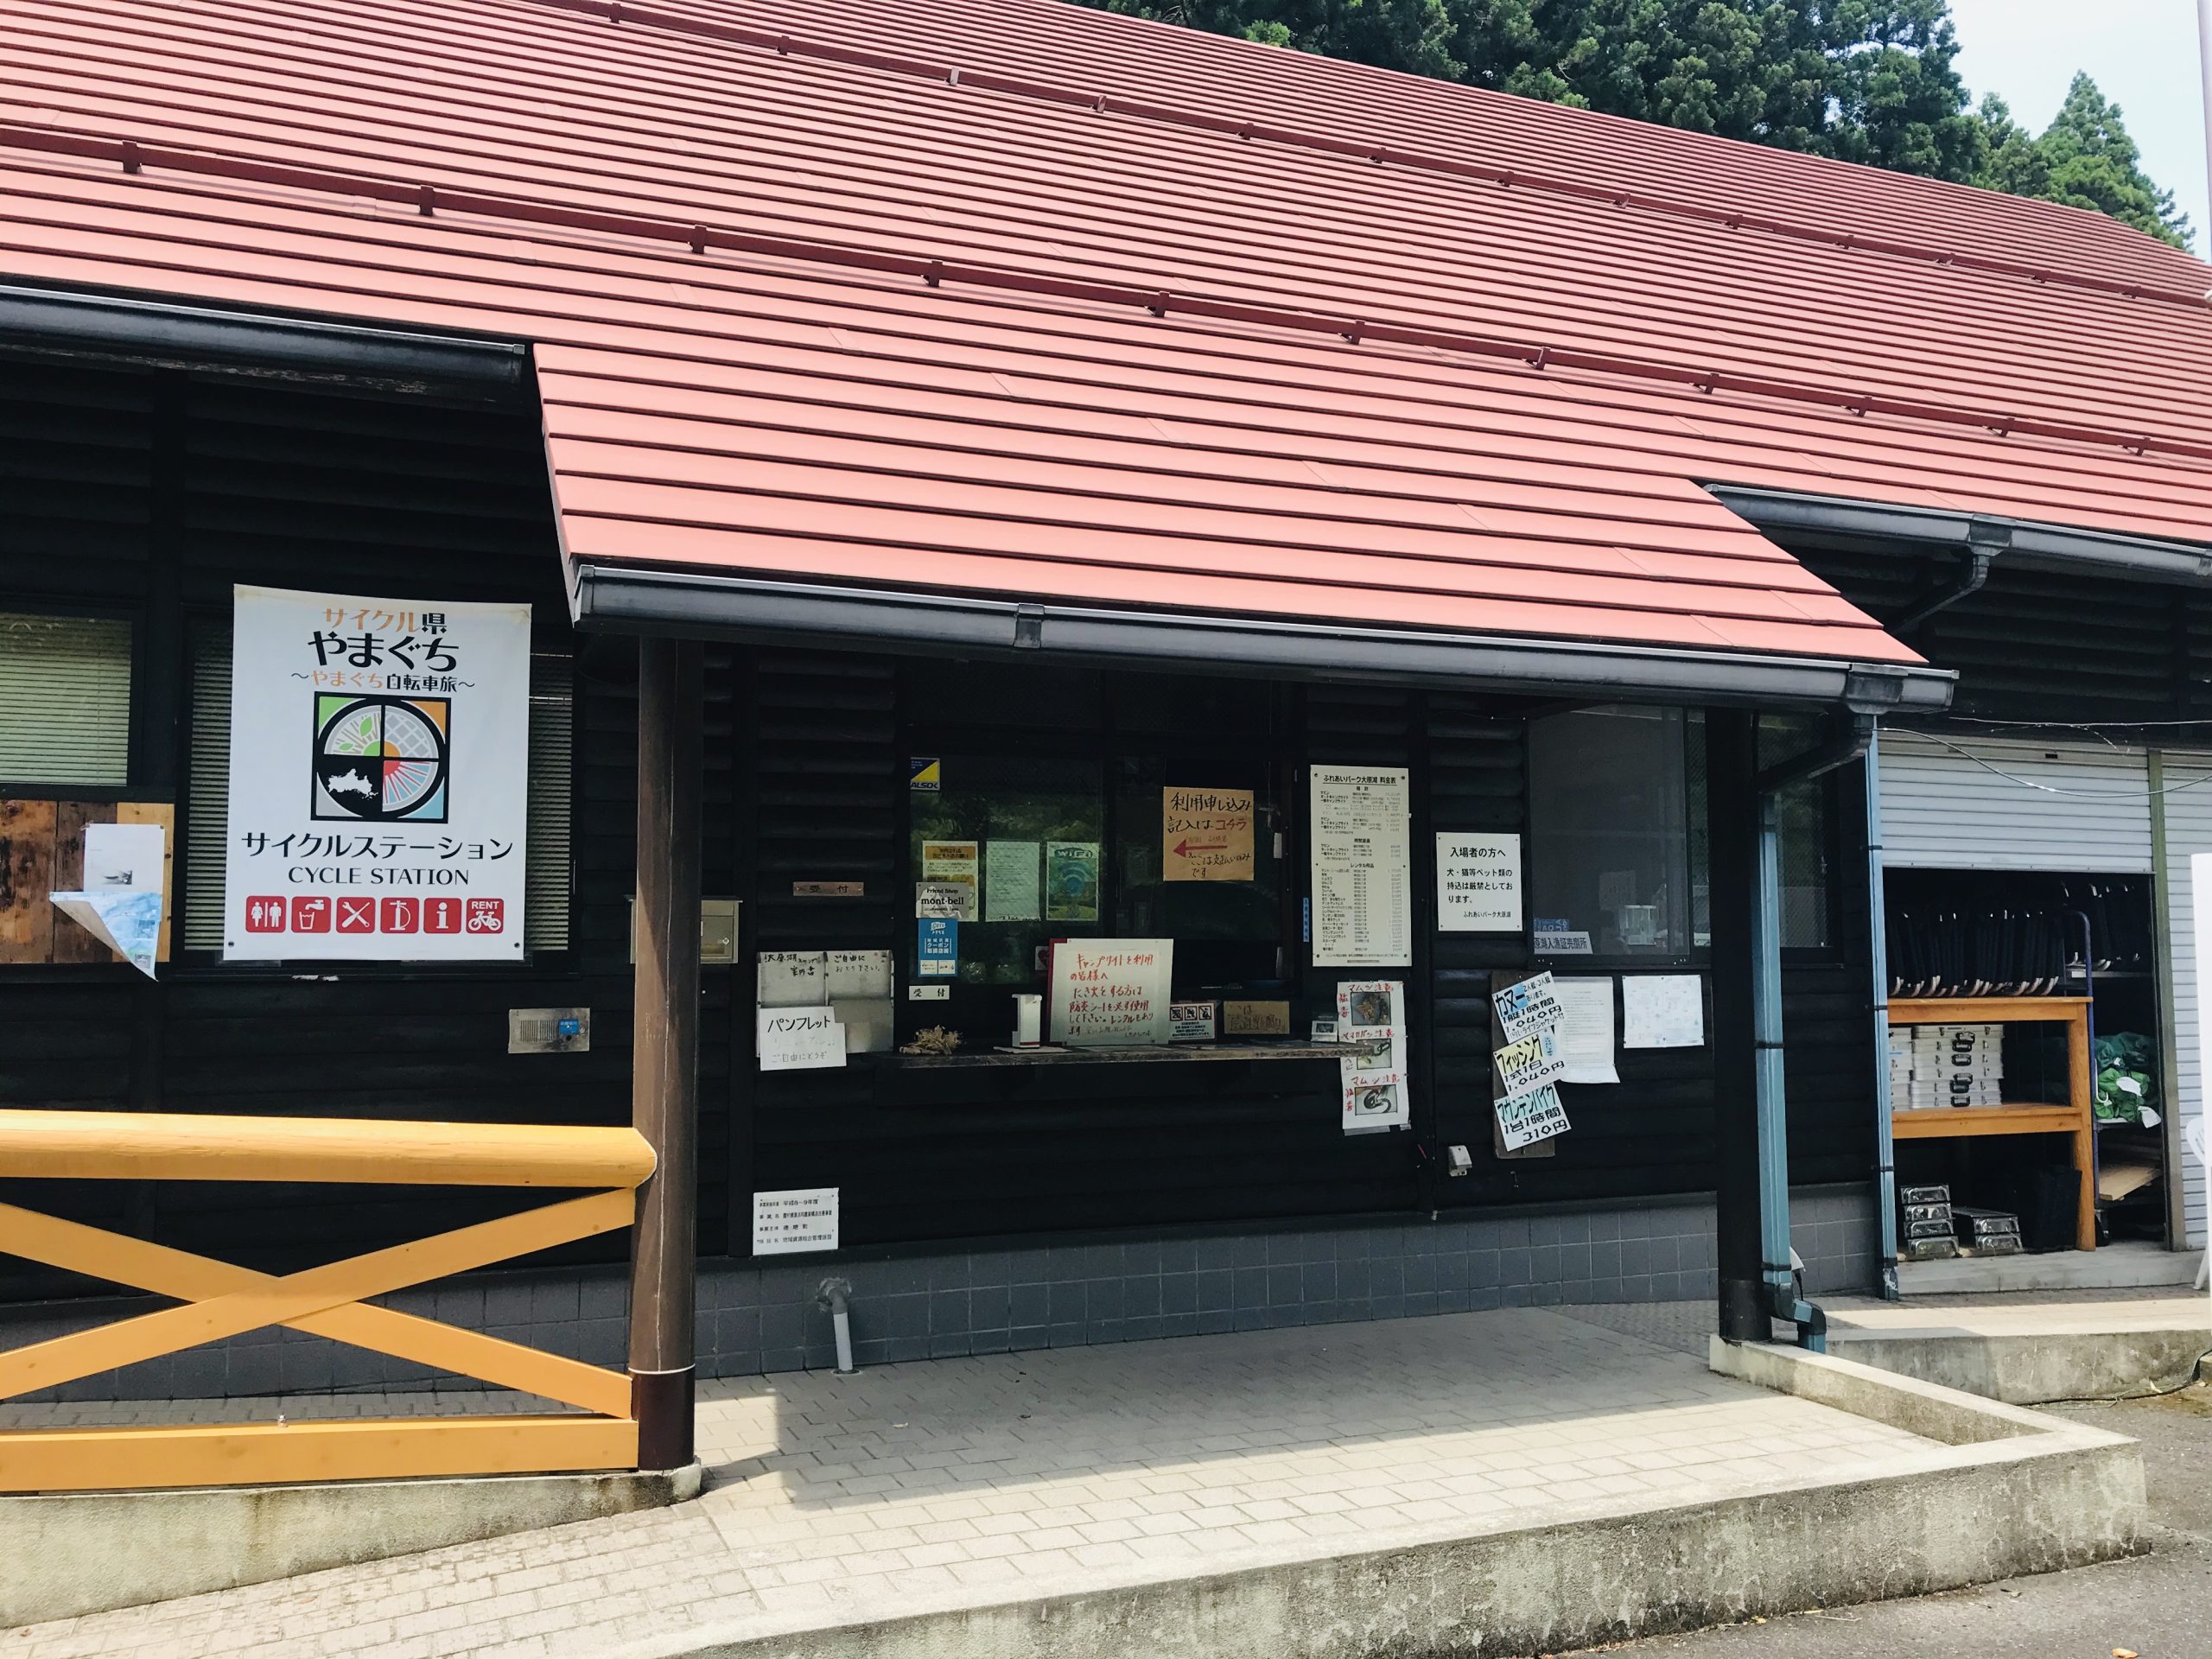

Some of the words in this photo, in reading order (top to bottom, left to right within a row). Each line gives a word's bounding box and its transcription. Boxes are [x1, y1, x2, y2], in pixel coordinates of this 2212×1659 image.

[322, 608, 447, 635] サイクル県
[308, 631, 460, 671] やまぐち
[1171, 791, 1251, 812] 利用申し込み
[241, 832, 513, 861] サイクルステーション
[1450, 847, 1506, 858] 入場者の方へ
[288, 867, 362, 885] CYCLE
[370, 868, 470, 886] STATION
[1446, 868, 1513, 877] 犬・猫等ペット類の
[1446, 881, 1513, 891] 持込は厳禁としてお
[471, 901, 499, 910] RENT
[921, 896, 964, 905] mont-bell
[913, 988, 945, 998] 受付
[1496, 989, 1525, 1018] カヌー
[767, 1015, 831, 1033] パンフレット
[1497, 1034, 1543, 1074] フィッシング
[1504, 1106, 1561, 1135] 1台1時間
[1522, 1119, 1567, 1142] 310円
